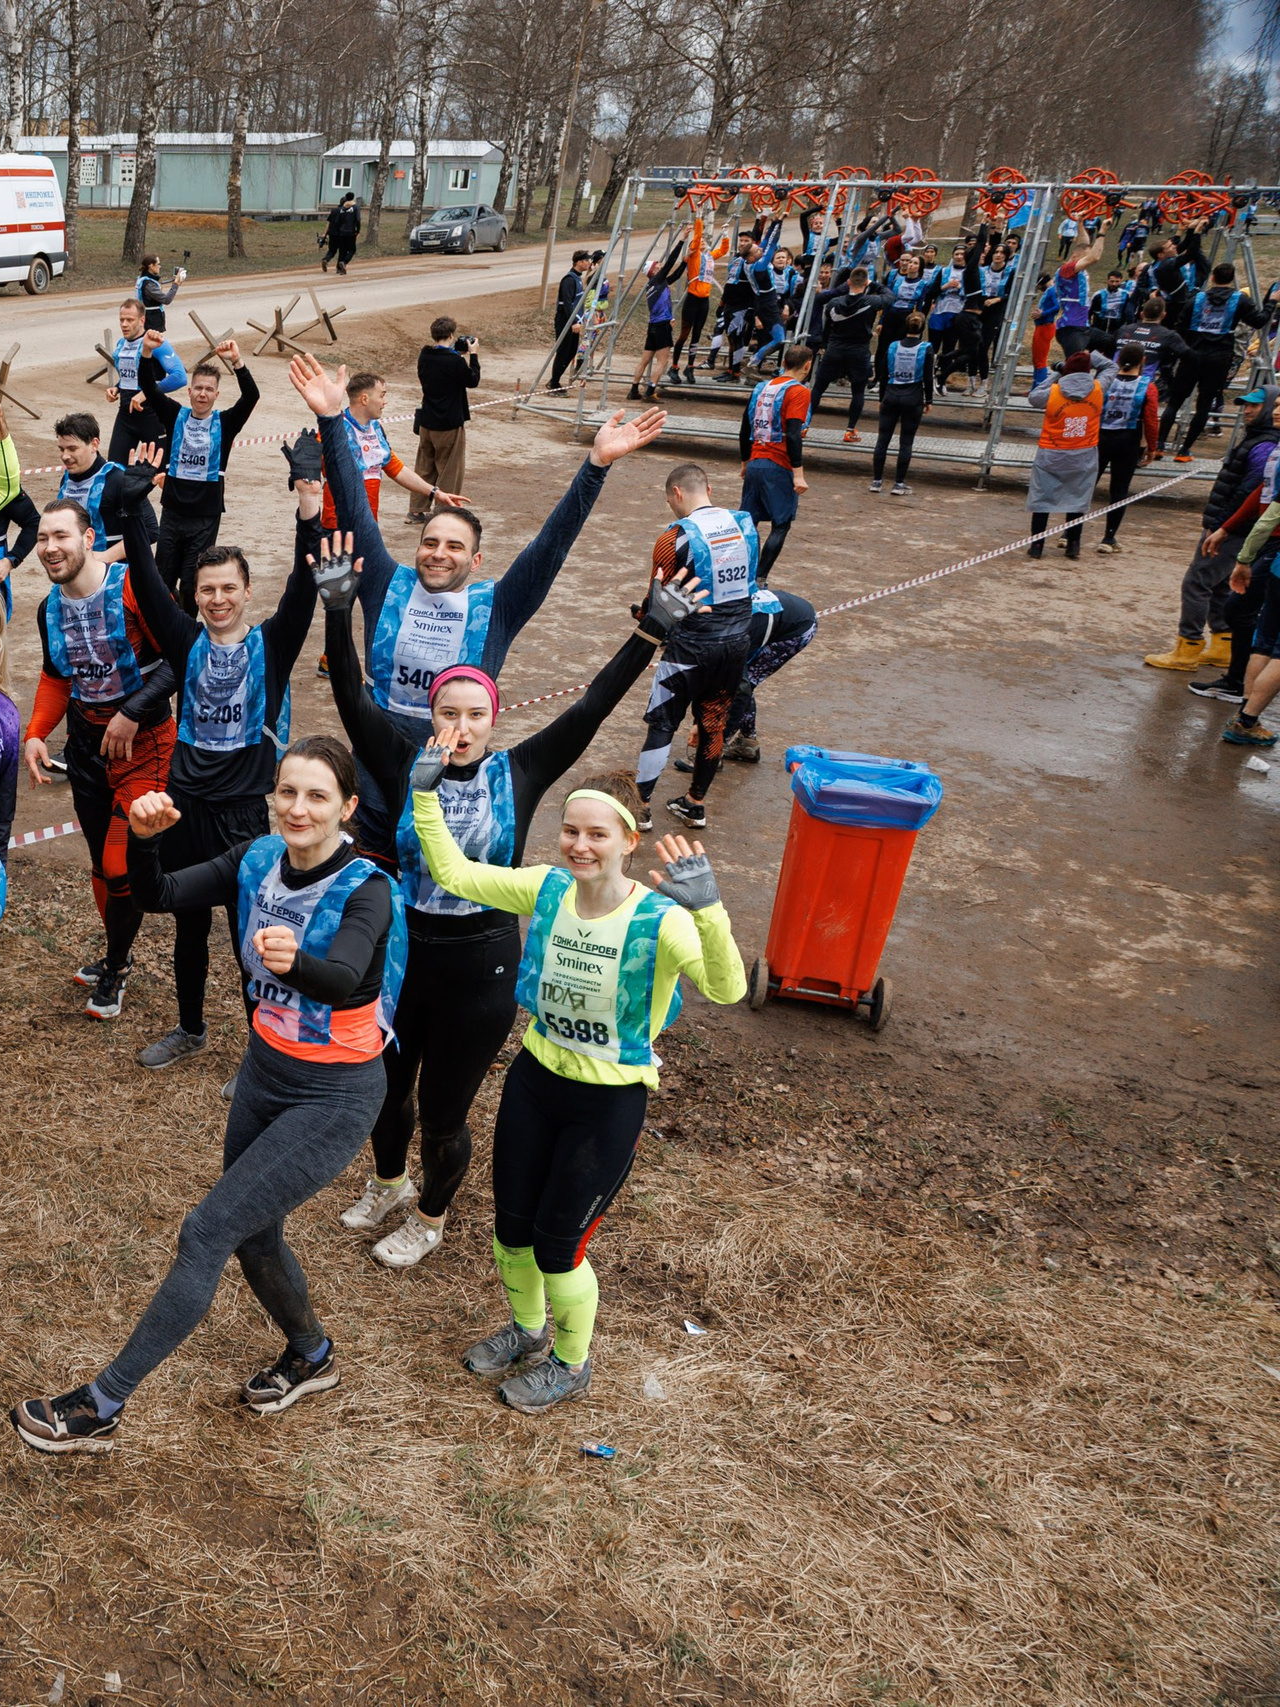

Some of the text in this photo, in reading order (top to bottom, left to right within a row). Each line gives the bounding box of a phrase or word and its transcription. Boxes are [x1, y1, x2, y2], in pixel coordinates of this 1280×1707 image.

[181, 454, 206, 466] 5409
[718, 565, 746, 584] 5322
[409, 608, 434, 617] ГОНКА
[413, 619, 452, 634] Sminex
[397, 666, 434, 690] 540
[198, 704, 242, 724] 5408
[444, 805, 479, 814] minex
[271, 903, 306, 923] ГЕРОЕВ
[553, 935, 618, 956] ГОНКА ГЕРОЕВ
[555, 952, 604, 975] Sminex
[564, 981, 601, 993] DEVELOPMENT
[545, 1012, 610, 1046] 5398
